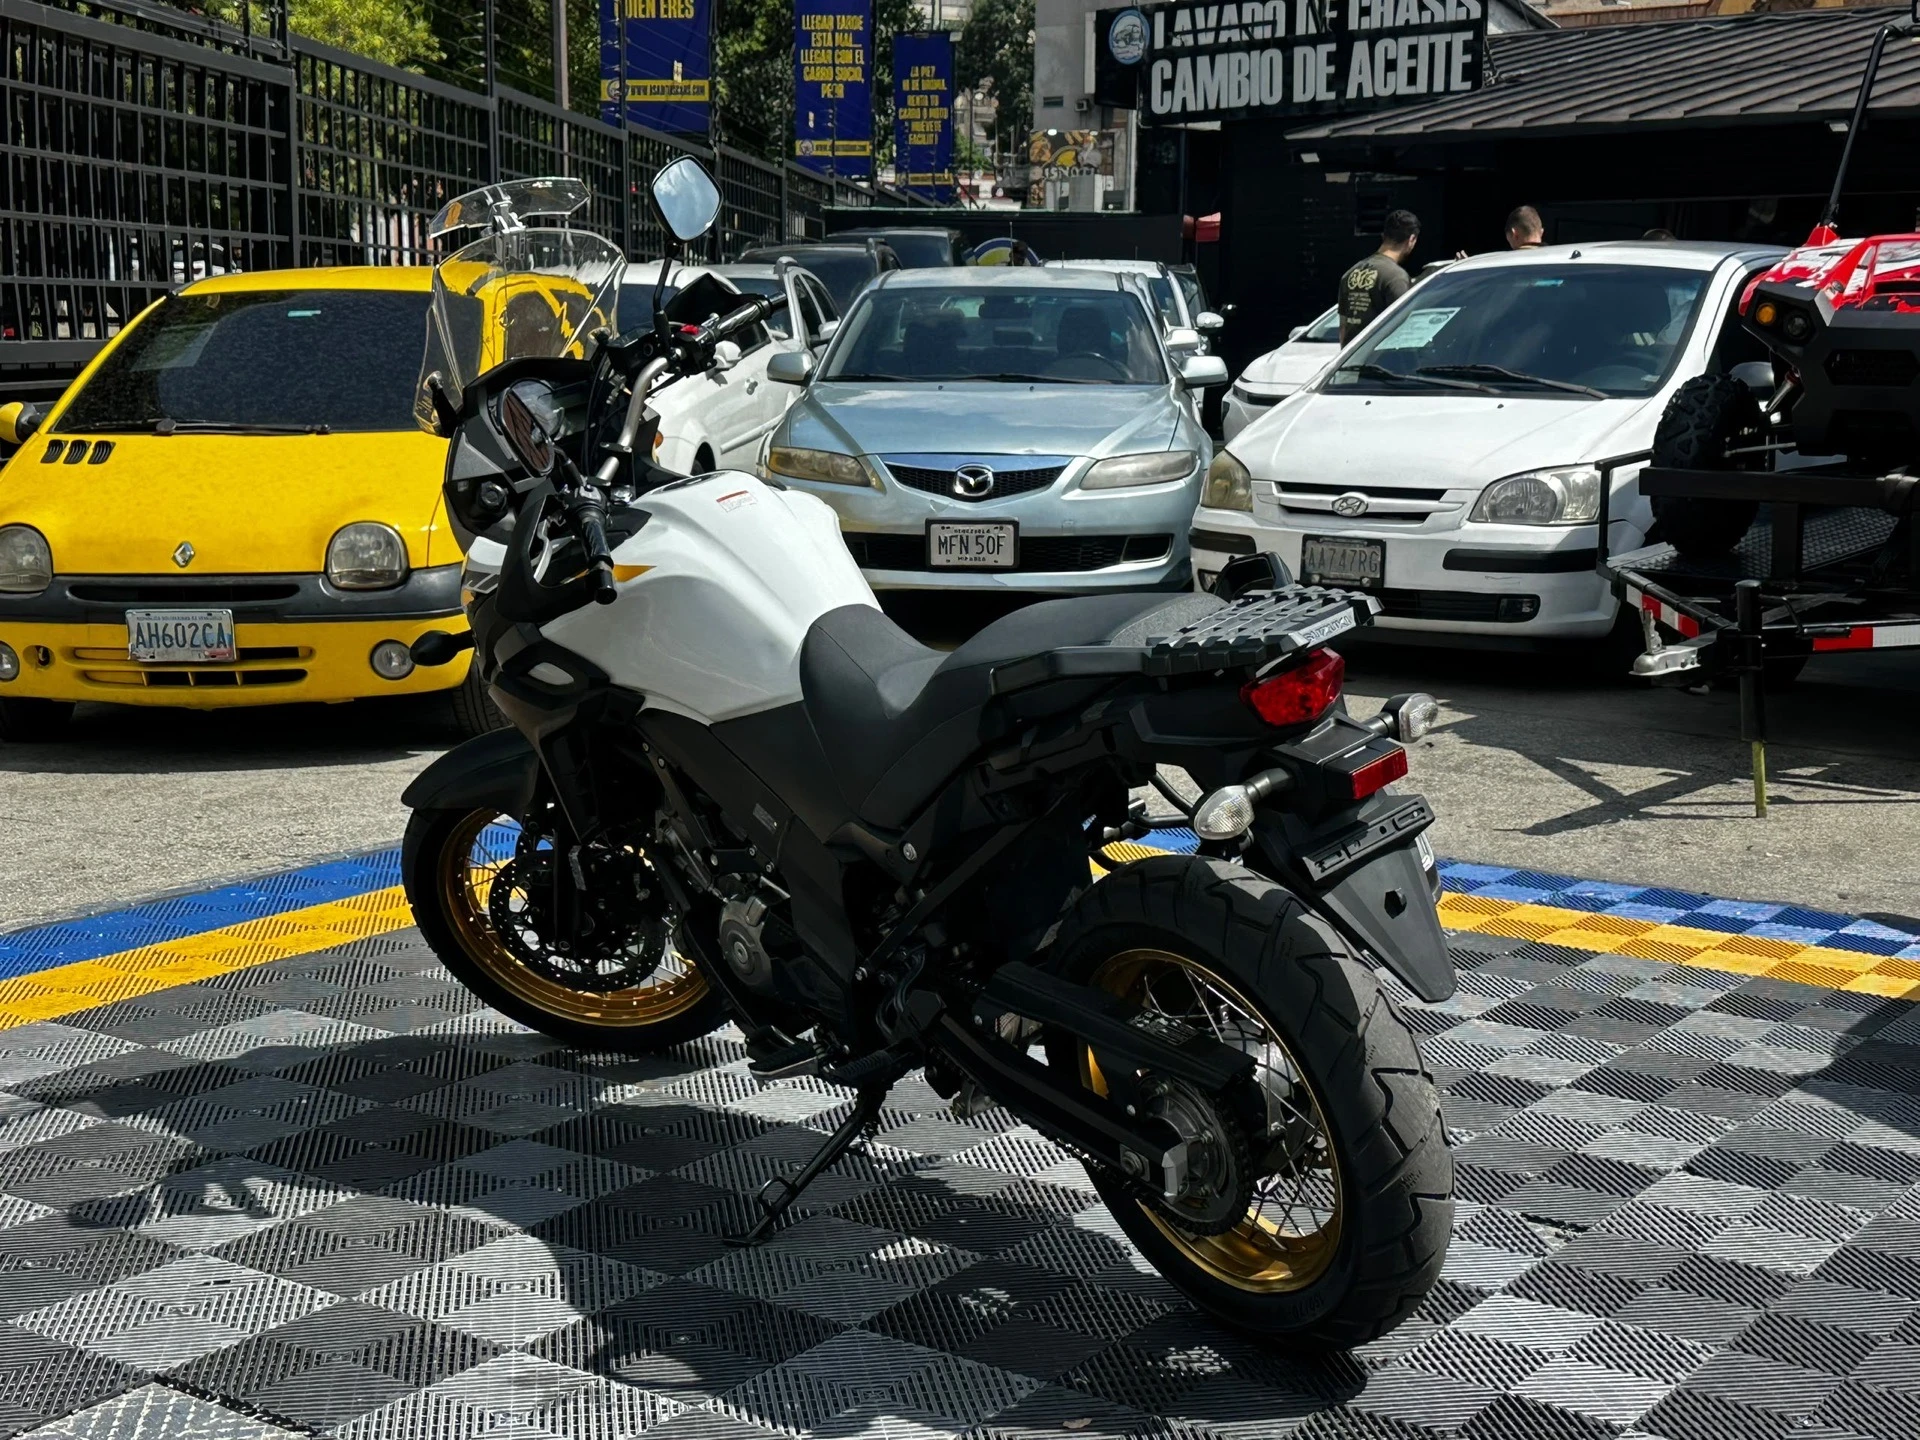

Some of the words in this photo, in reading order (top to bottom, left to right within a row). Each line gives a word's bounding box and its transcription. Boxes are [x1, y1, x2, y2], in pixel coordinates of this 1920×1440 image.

[660, 0, 694, 19] ERES
[834, 49, 853, 64] CON
[855, 49, 865, 65] EL
[1151, 48, 1283, 115] CAMBIO
[1292, 43, 1337, 103] DE
[1346, 31, 1475, 99] ACEITE
[938, 535, 969, 555] MFN
[975, 535, 1007, 555] 50F
[136, 622, 227, 649] AH602CA
[1302, 615, 1352, 641] SUZUKI
